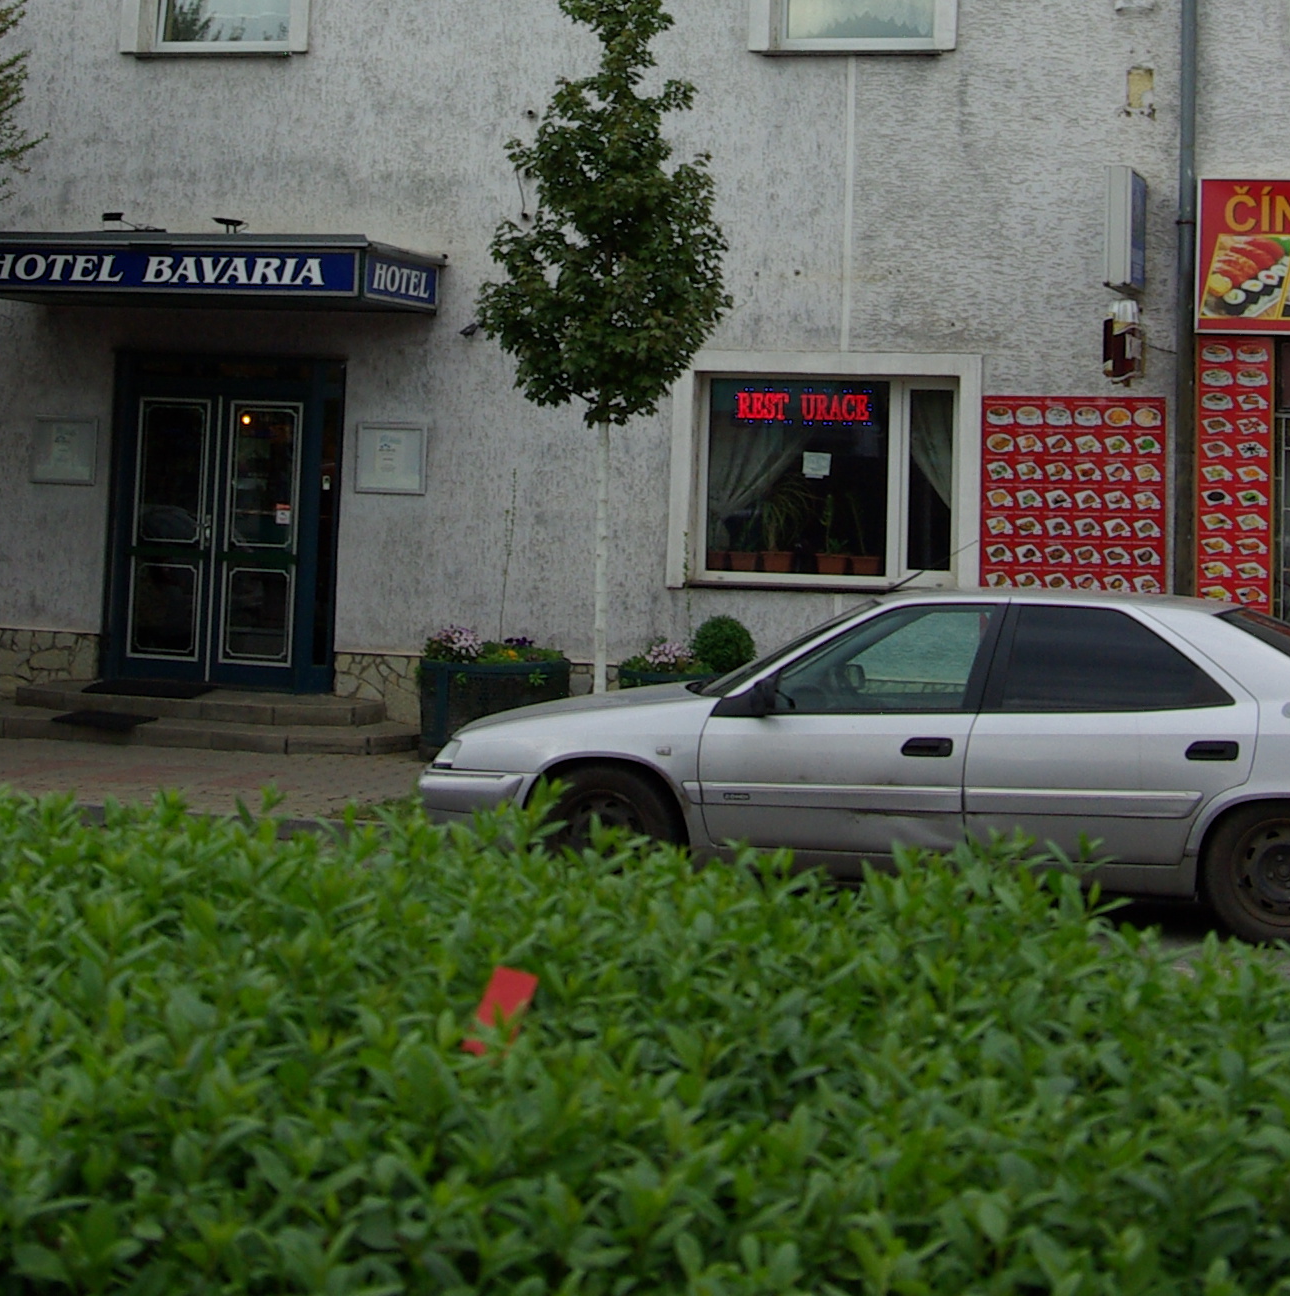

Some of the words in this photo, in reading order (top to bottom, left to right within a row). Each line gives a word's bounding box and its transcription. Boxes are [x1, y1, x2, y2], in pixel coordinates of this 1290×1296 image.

[142, 256, 325, 286] BAVARIA
[372, 263, 430, 298] HOTEL
[737, 392, 790, 421] REST
[800, 394, 870, 421] URACE
